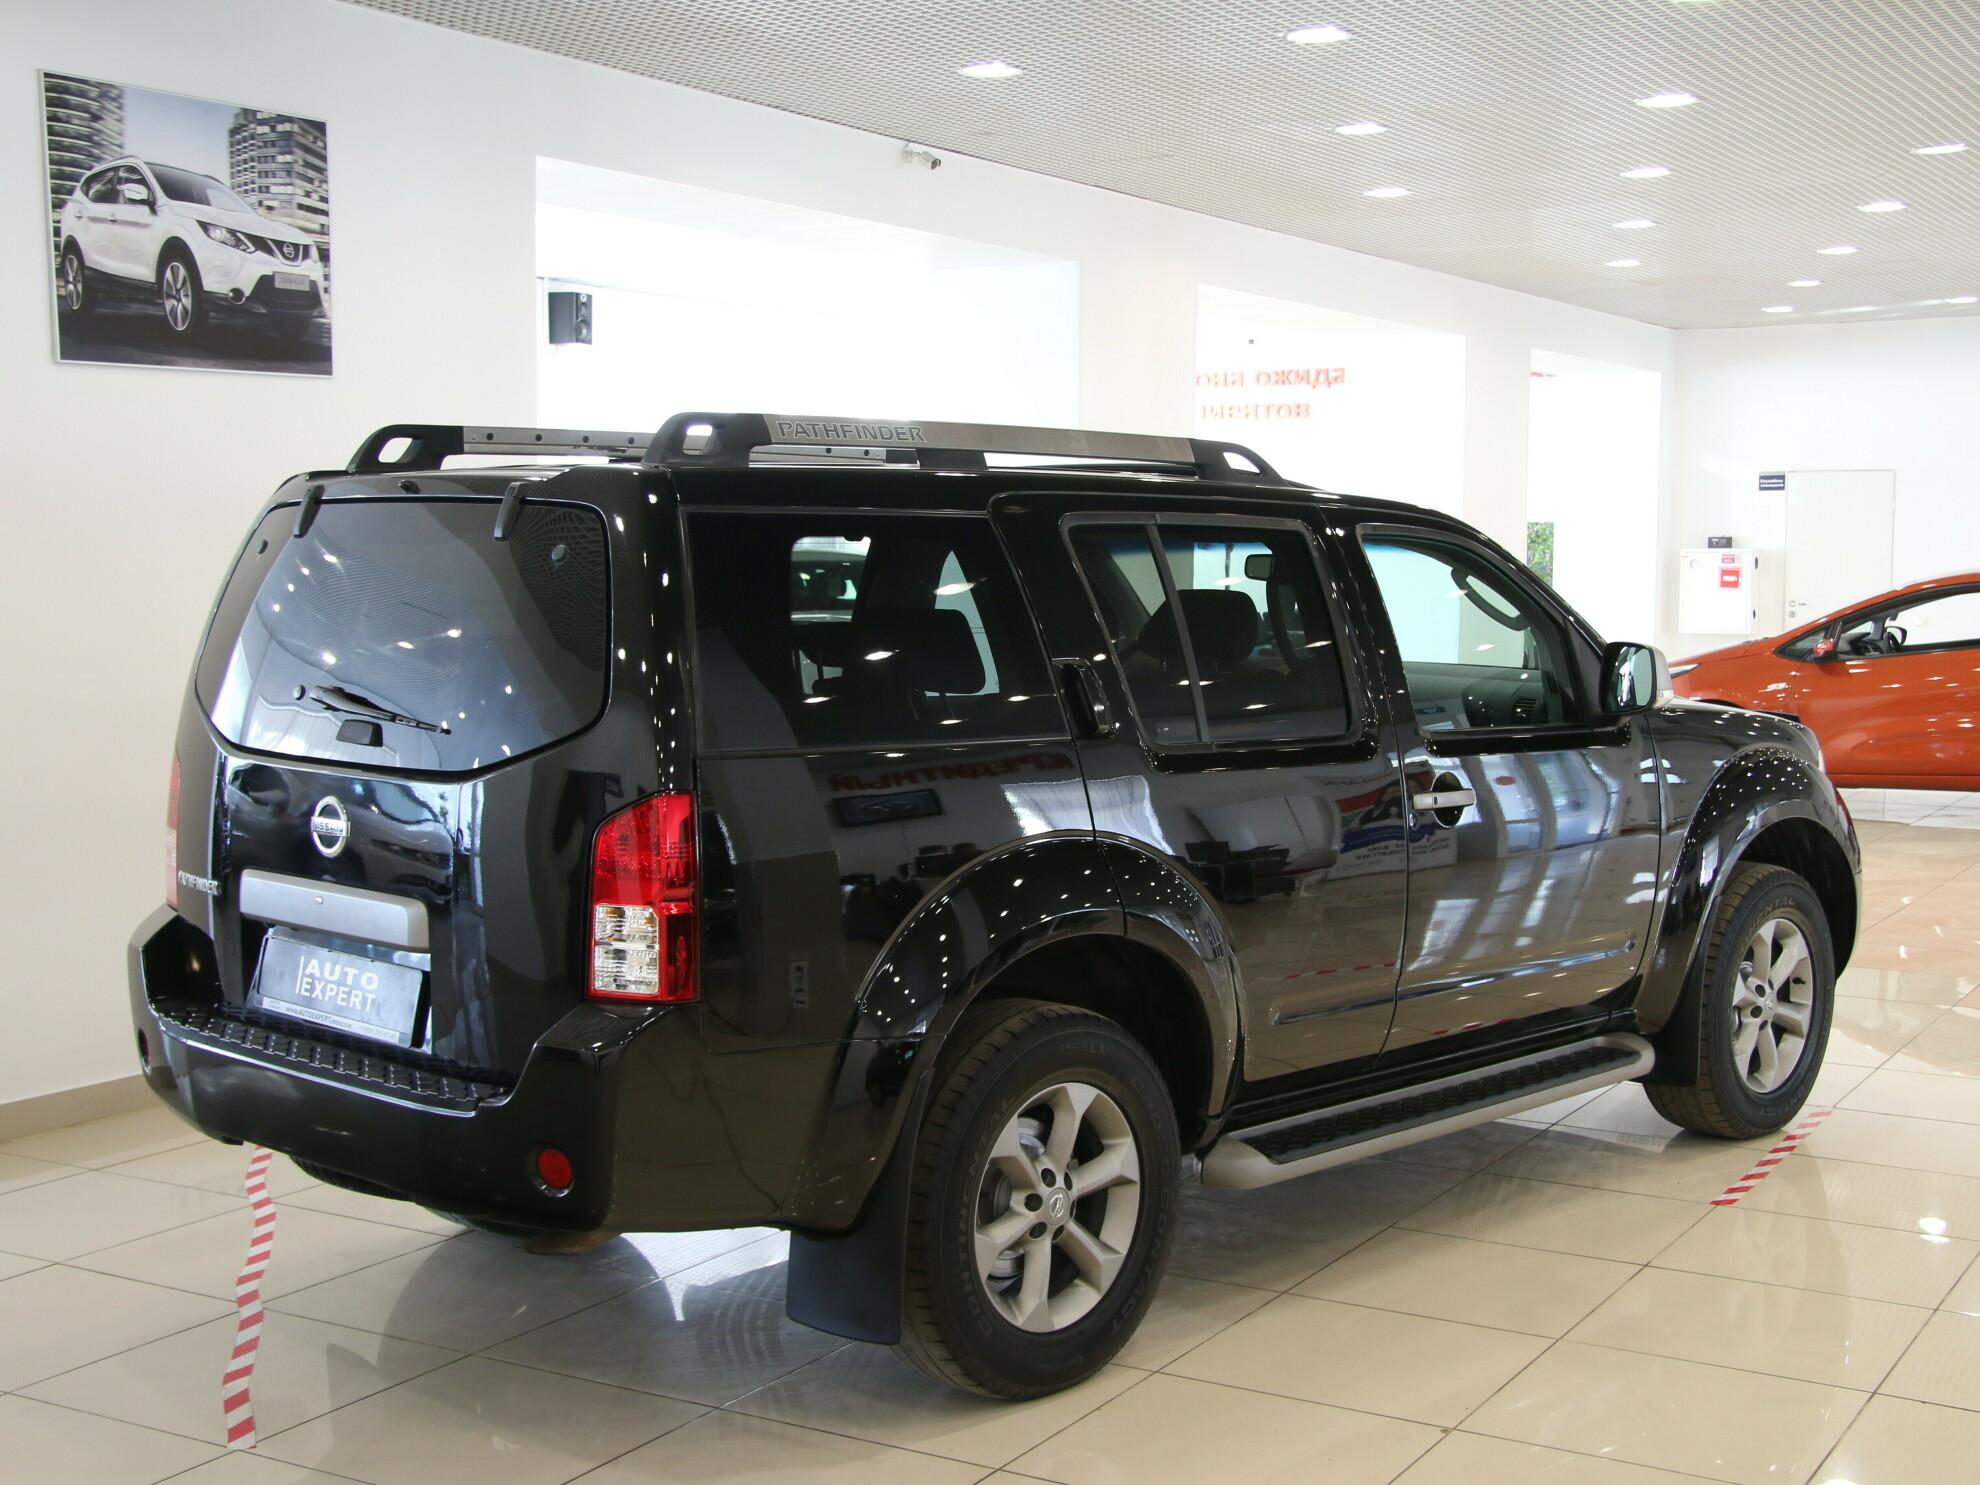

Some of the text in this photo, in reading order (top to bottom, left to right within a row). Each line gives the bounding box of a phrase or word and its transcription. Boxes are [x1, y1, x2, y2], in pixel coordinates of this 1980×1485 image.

[1255, 367, 1346, 389] ожида
[776, 420, 927, 443] PATHFINDER
[312, 820, 344, 833] NISSAN
[304, 958, 379, 991] AUTO
[301, 978, 376, 1013] EXPERT
